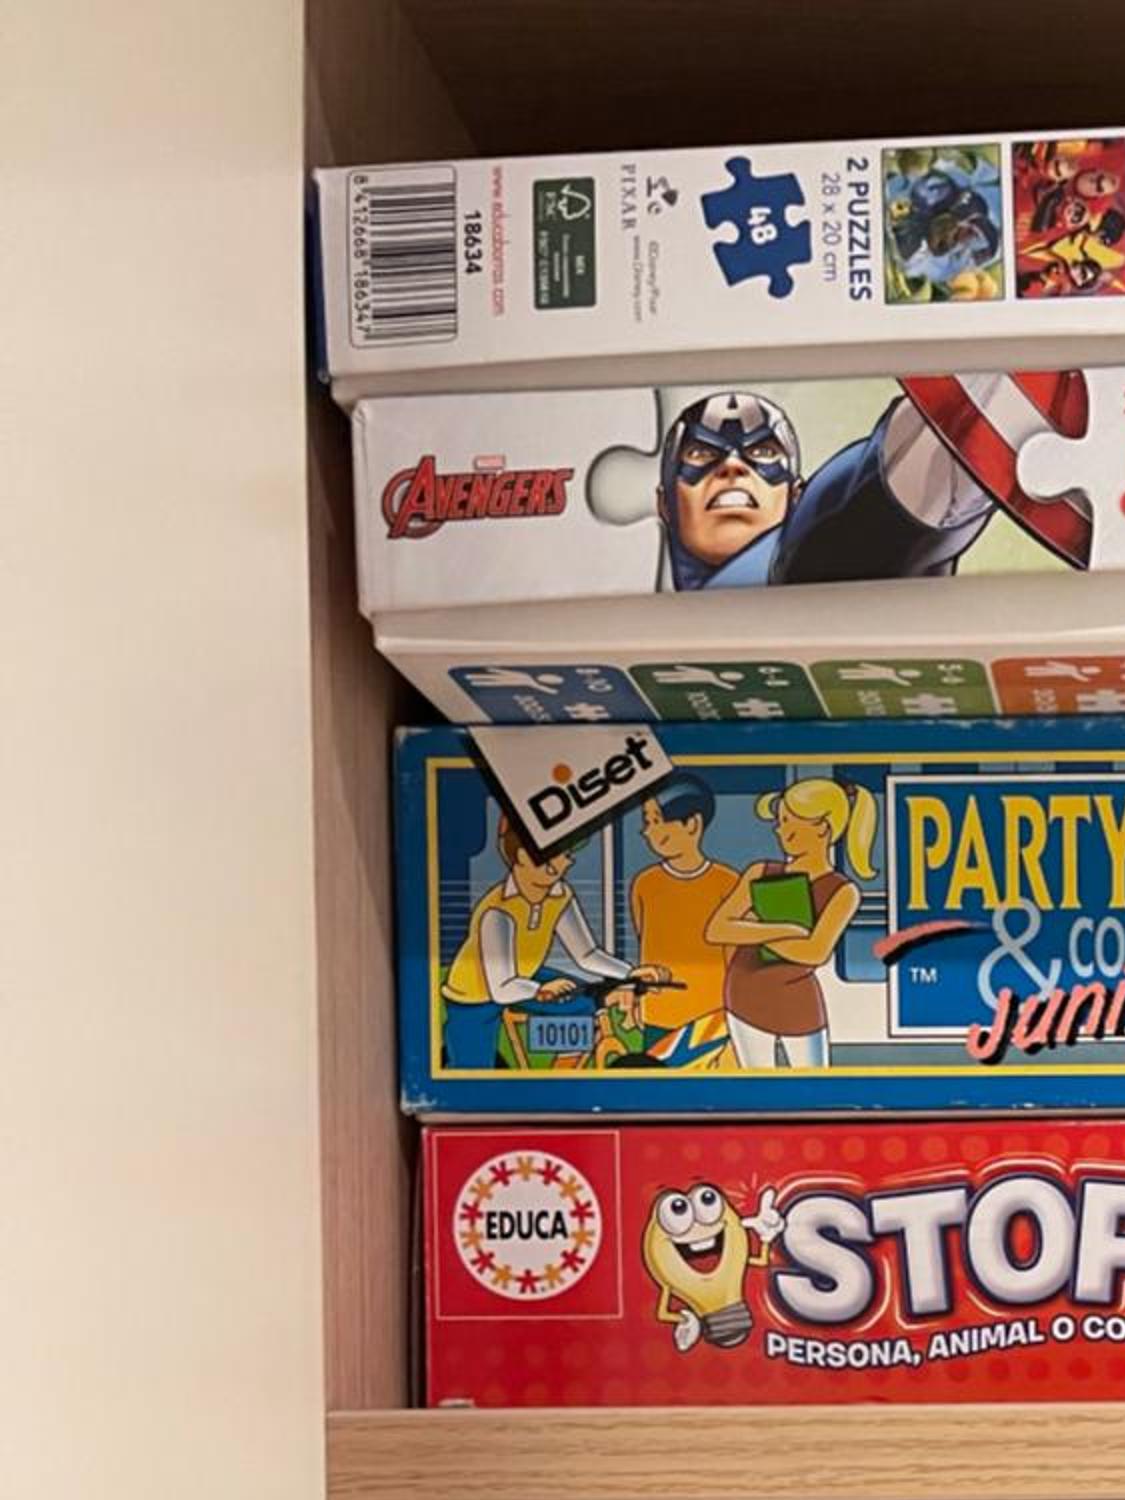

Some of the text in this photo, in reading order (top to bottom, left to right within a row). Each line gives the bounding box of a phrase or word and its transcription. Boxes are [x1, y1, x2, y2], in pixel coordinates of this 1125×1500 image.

[621, 164, 637, 231] PIXAR
[747, 206, 774, 245] 48
[821, 172, 842, 282] 28 x 20 cm
[848, 157, 872, 301] 2 PUZZLES
[353, 174, 370, 333] 8 412668 186347
[463, 210, 482, 275] 18634
[382, 454, 575, 540] AVENGERS
[526, 733, 653, 831] Diset
[908, 967, 937, 984] TM
[977, 897, 1062, 1012] &
[536, 1022, 591, 1047] 10101
[485, 1210, 568, 1240] EDUCA
[766, 1332, 923, 1367] PERSONA,
[929, 1319, 1045, 1360] ANIMAL
[1053, 1316, 1077, 1340] O
